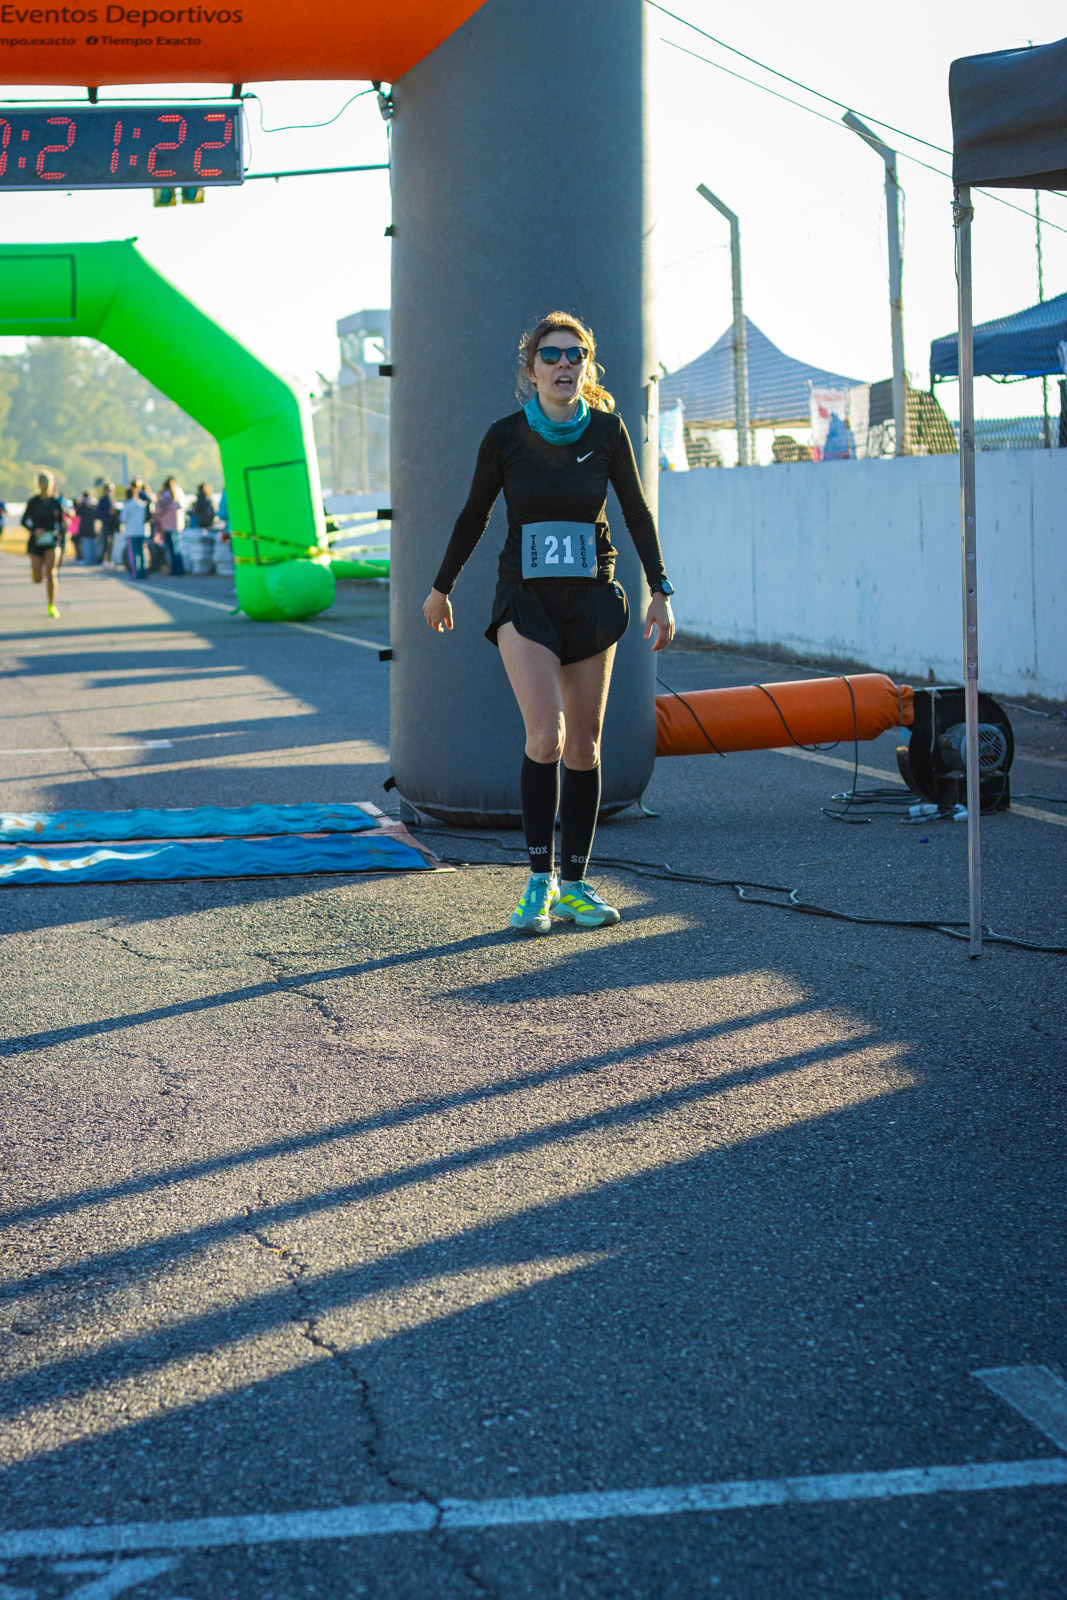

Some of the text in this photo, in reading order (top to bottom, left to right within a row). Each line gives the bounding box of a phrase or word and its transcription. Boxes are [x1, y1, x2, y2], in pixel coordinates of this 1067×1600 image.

[1, 5, 243, 27] Eventos Deportivos
[101, 36, 202, 47] Tiempo Exacto
[530, 534, 538, 568] TIEMPO
[544, 535, 575, 564] 21
[580, 534, 588, 568] EXACTO
[528, 846, 547, 855] SOX
